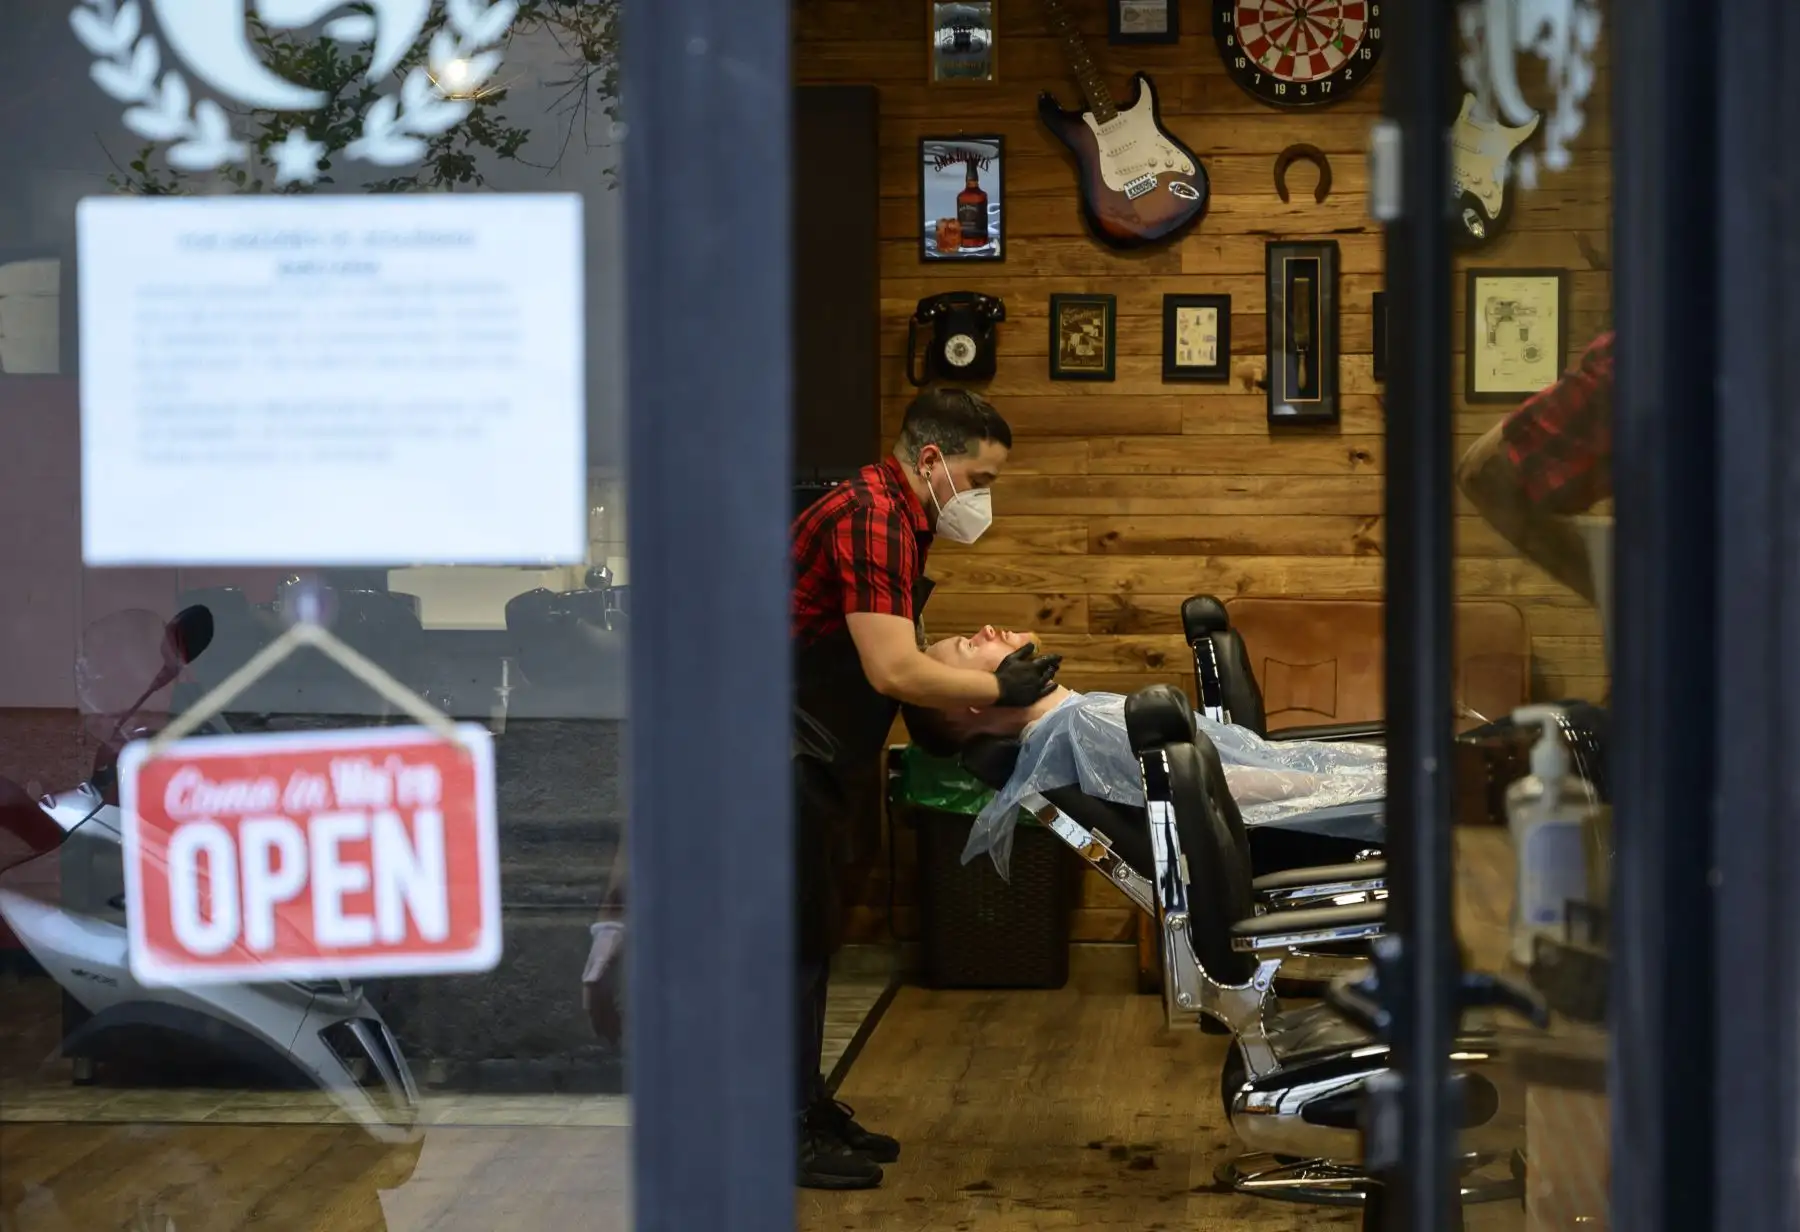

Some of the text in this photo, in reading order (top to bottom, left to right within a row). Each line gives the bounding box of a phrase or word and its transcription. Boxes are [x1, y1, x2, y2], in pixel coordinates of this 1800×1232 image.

[1372, 4, 1379, 17] 6
[1222, 12, 1231, 23] 11
[1369, 28, 1381, 39] 10
[1227, 35, 1234, 46] 8
[1360, 48, 1371, 60] 15
[1235, 57, 1246, 69] 16
[1254, 73, 1261, 85] 7
[1345, 69, 1352, 80] 2
[1274, 83, 1286, 95] 19
[1300, 84, 1307, 95] 3
[1320, 82, 1332, 93] 17
[164, 764, 280, 820] Come
[281, 767, 330, 813] in
[167, 808, 450, 957] OPEN
